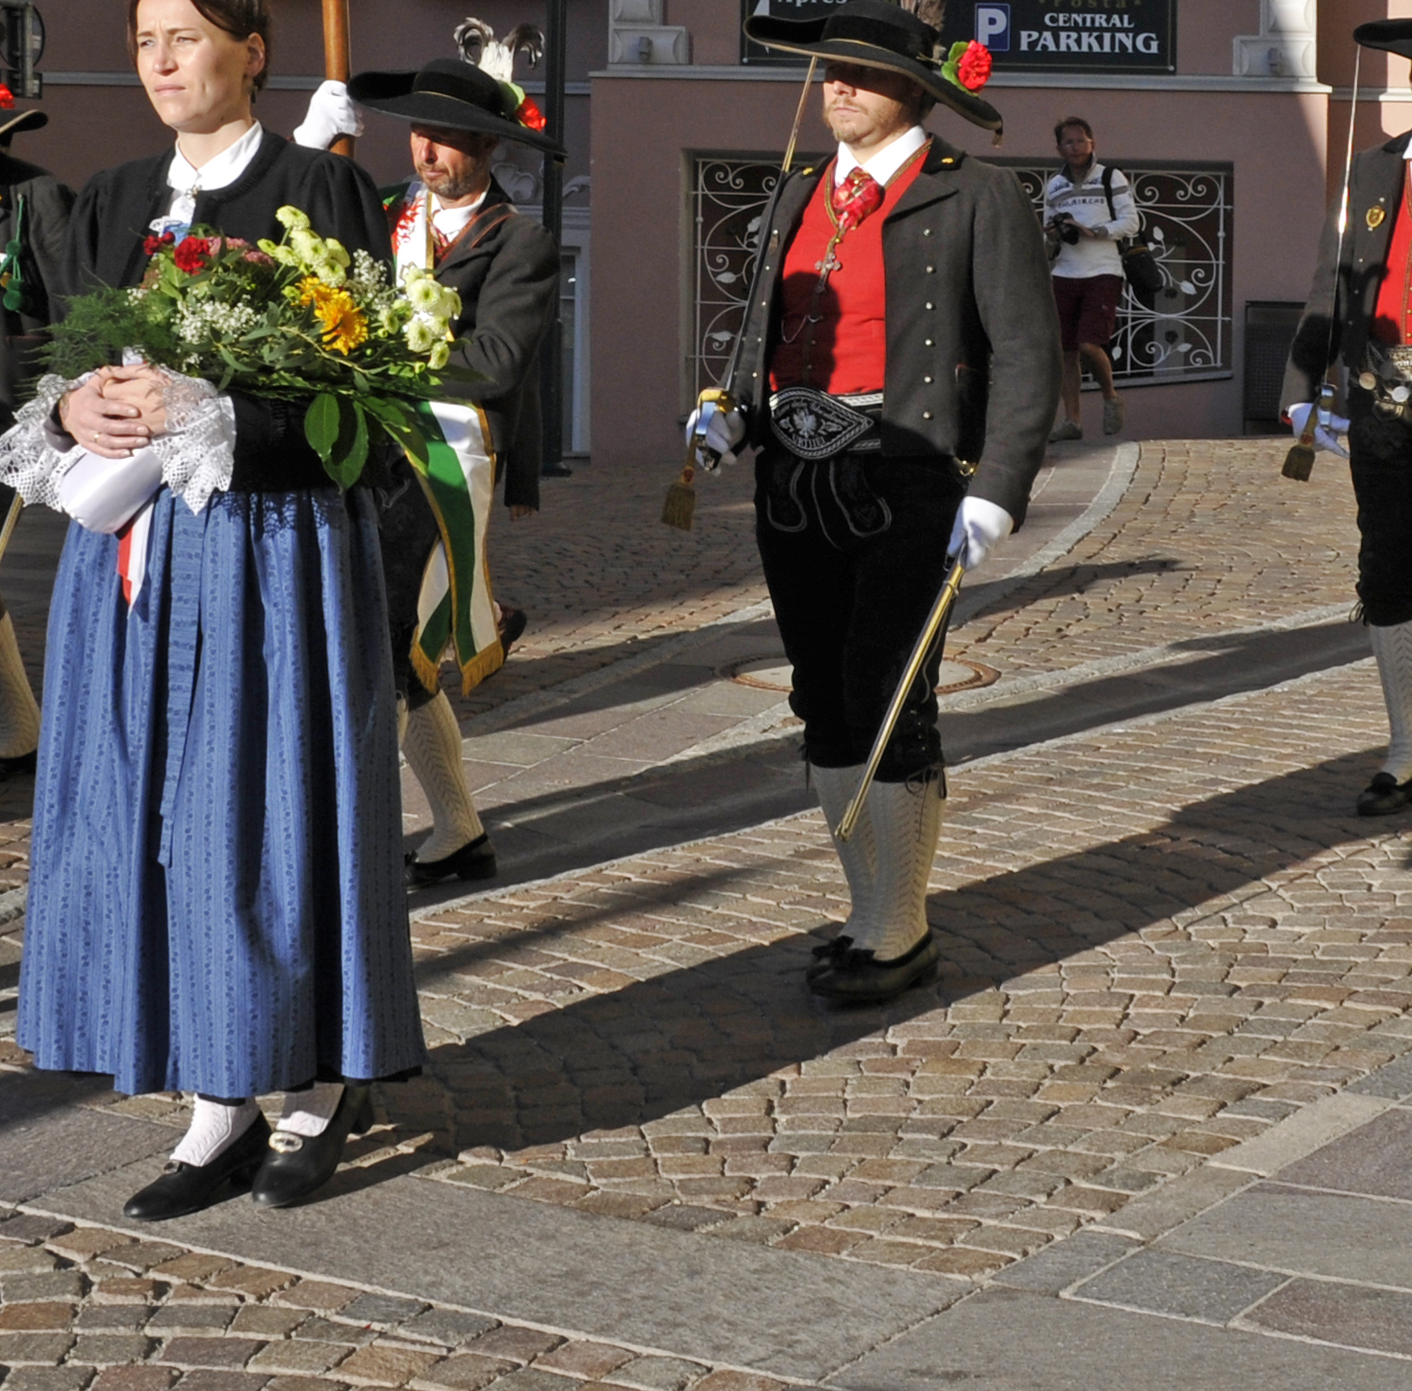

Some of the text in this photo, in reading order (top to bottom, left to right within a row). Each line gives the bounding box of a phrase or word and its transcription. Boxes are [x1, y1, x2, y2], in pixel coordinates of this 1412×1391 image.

[977, 7, 1008, 47] P
[1043, 12, 1136, 29] CENTRAL
[1018, 29, 1160, 55] PARKING
